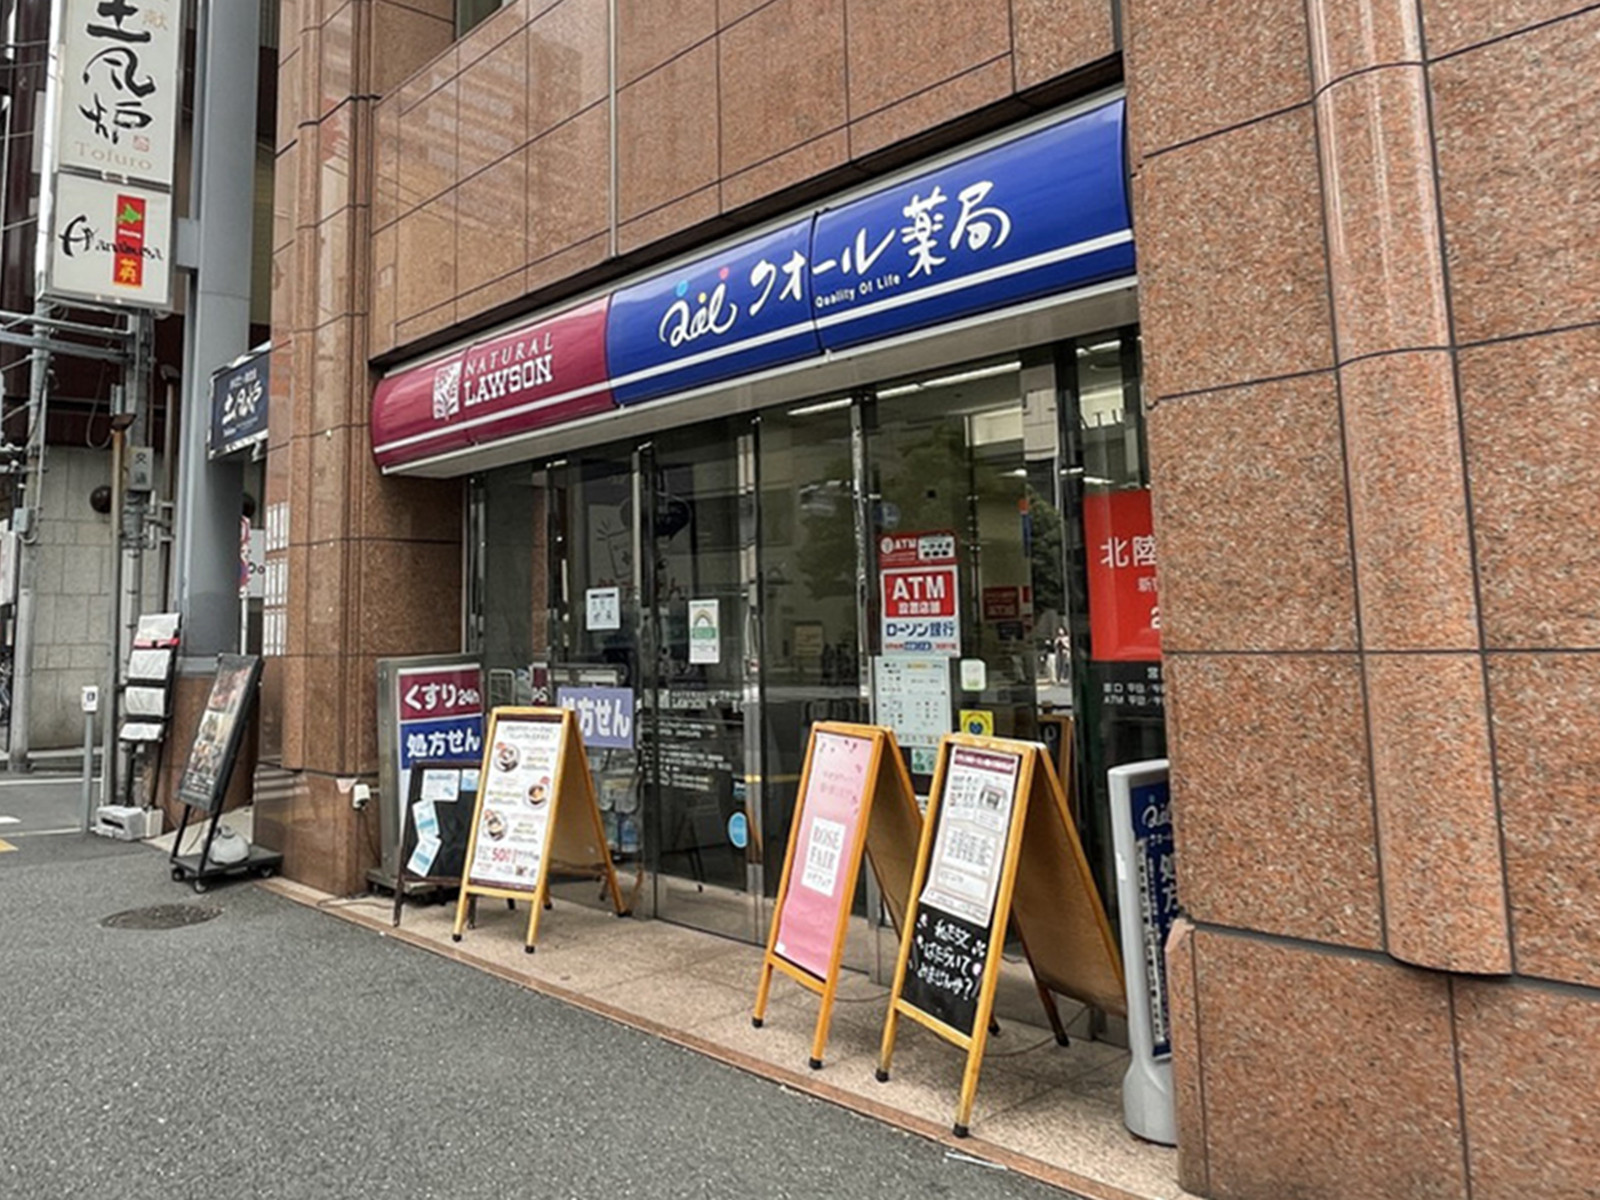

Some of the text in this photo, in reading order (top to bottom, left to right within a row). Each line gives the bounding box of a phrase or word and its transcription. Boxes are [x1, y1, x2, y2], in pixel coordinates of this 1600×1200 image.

[748, 180, 1012, 317] クオール薬局
[859, 281, 873, 296] Of
[876, 273, 901, 291] Life
[464, 332, 553, 378] NATURAL
[463, 354, 554, 407] LAWSON
[894, 538, 918, 550] ATM
[892, 575, 945, 600] ATM
[886, 621, 955, 638] ローソン銀行
[406, 727, 481, 759] 処方せん
